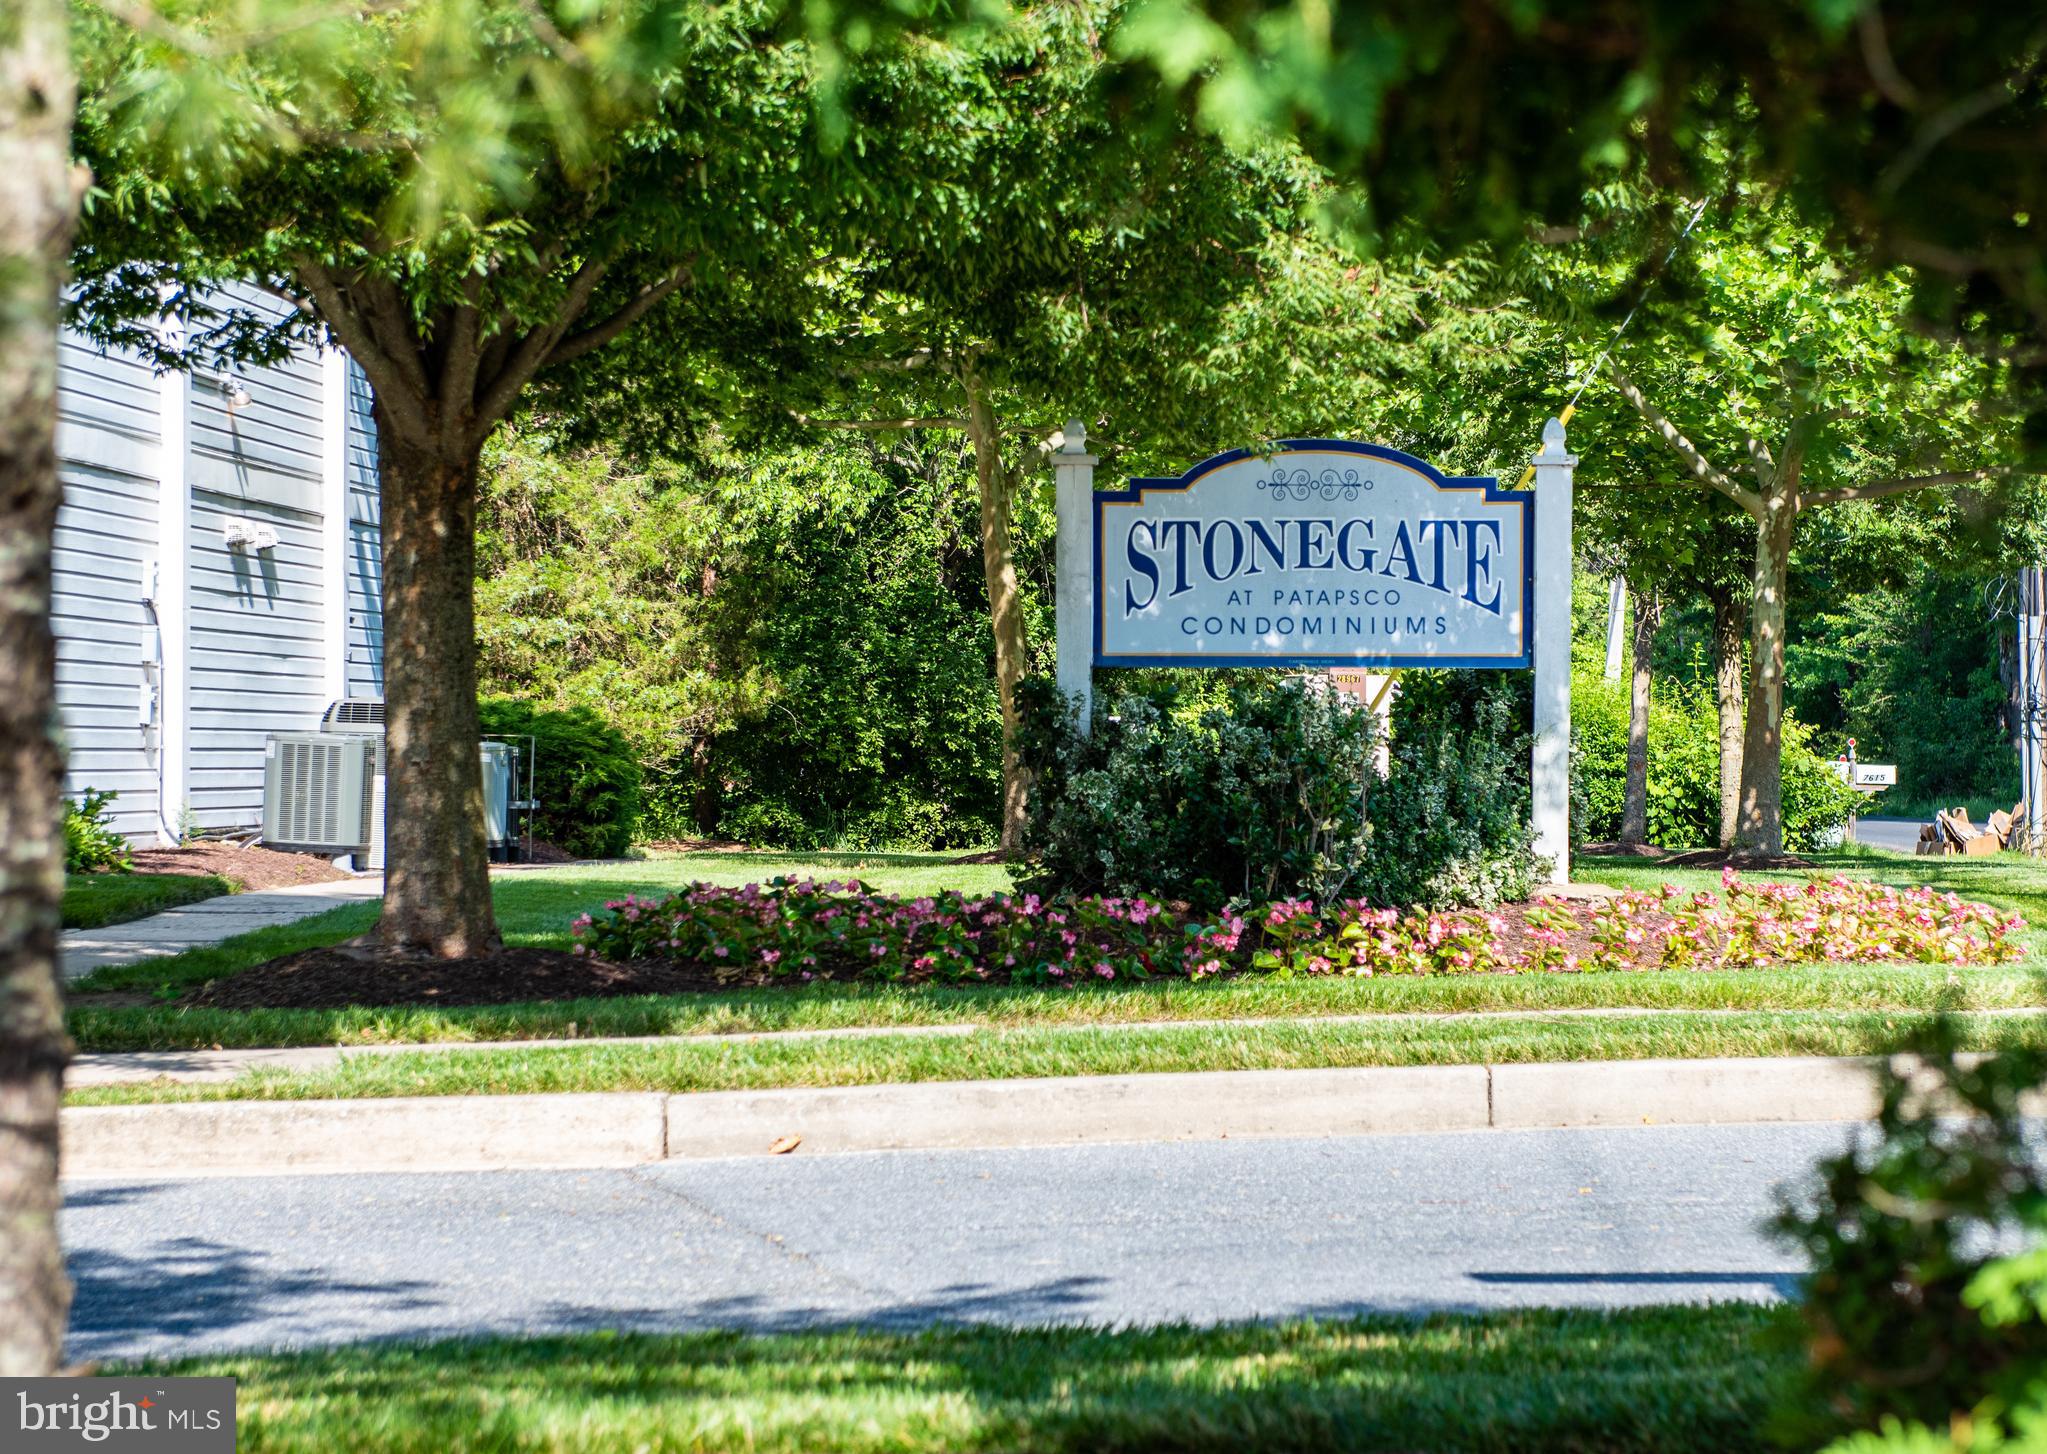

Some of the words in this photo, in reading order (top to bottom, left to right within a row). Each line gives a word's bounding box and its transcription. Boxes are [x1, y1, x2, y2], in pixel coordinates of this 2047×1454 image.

[1125, 518, 1502, 617] STONEGATE
[1227, 590, 1253, 606] AT
[1274, 589, 1401, 606] PATAPSCO
[1181, 616, 1447, 636] CONDOMINIUMS
